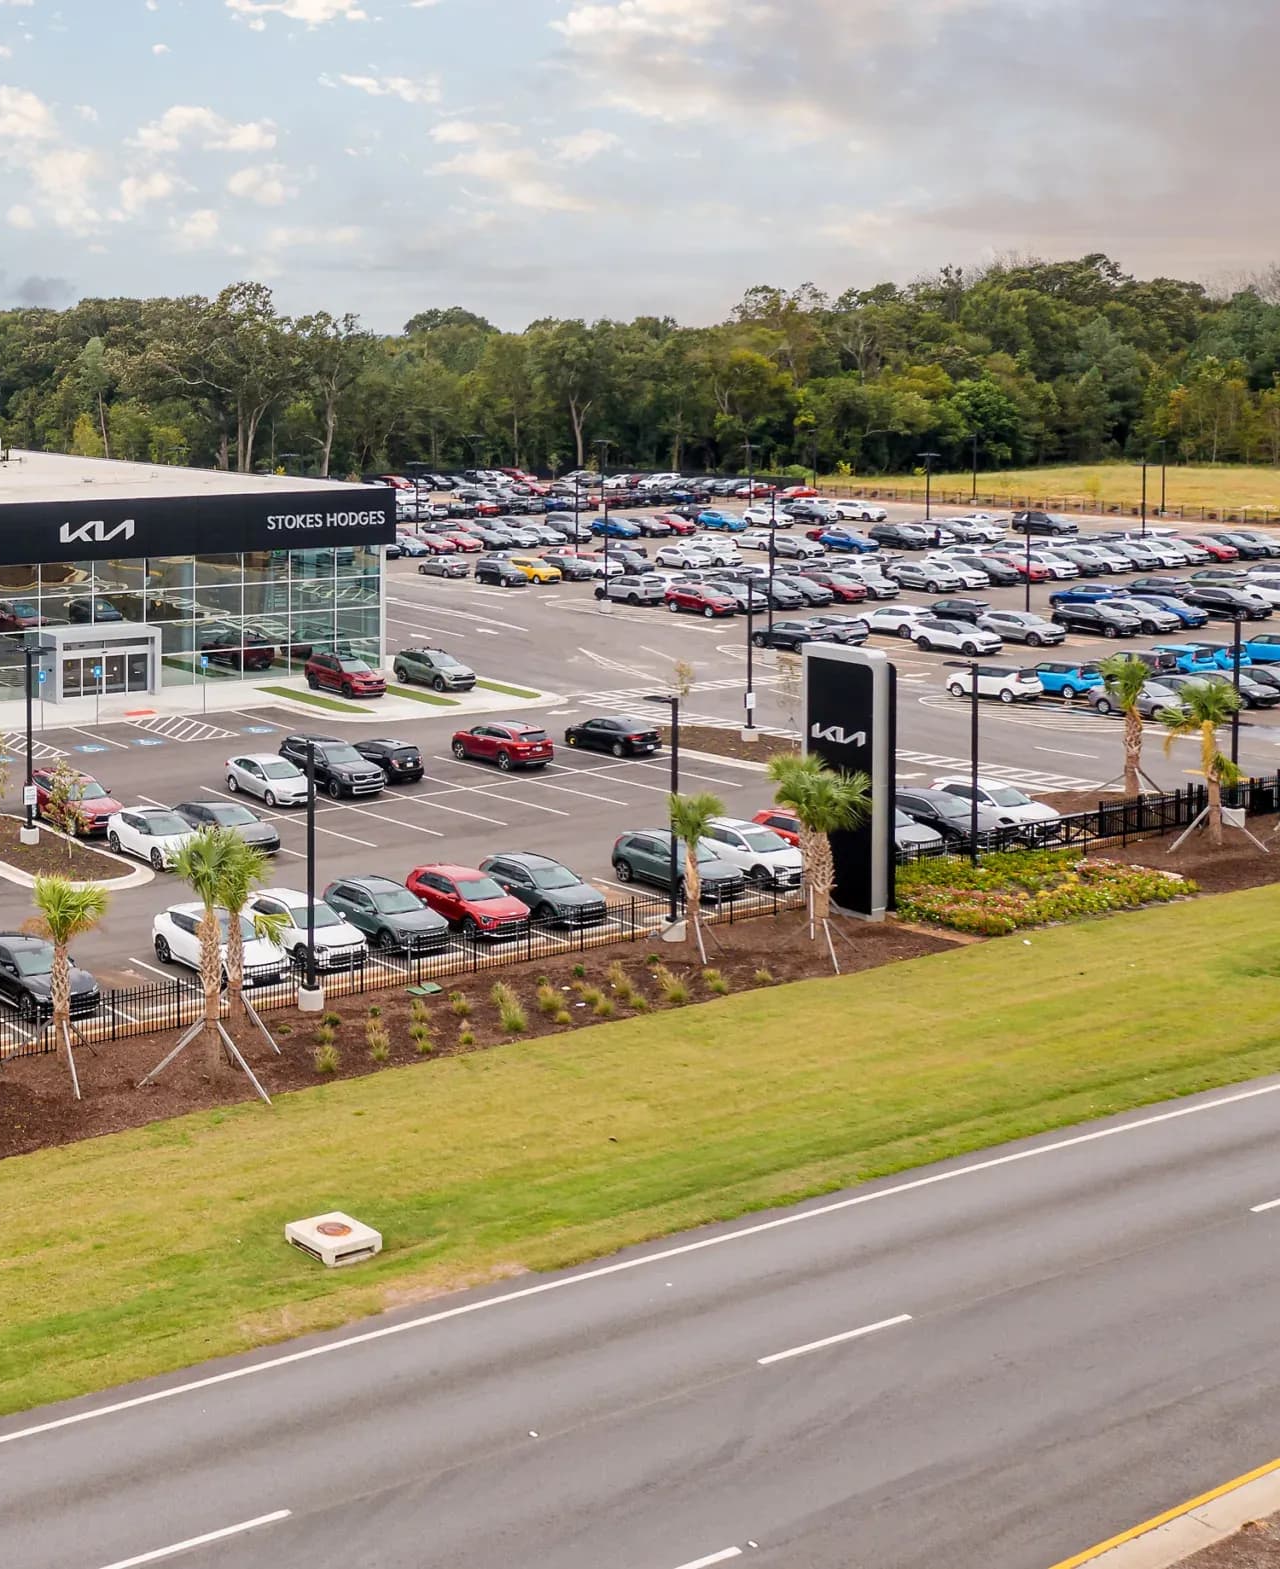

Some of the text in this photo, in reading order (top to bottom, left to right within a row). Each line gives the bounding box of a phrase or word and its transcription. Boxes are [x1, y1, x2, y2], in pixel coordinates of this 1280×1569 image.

[60, 520, 135, 543] KIA
[266, 510, 386, 530] STOKES HODGES
[811, 722, 866, 748] KIA
